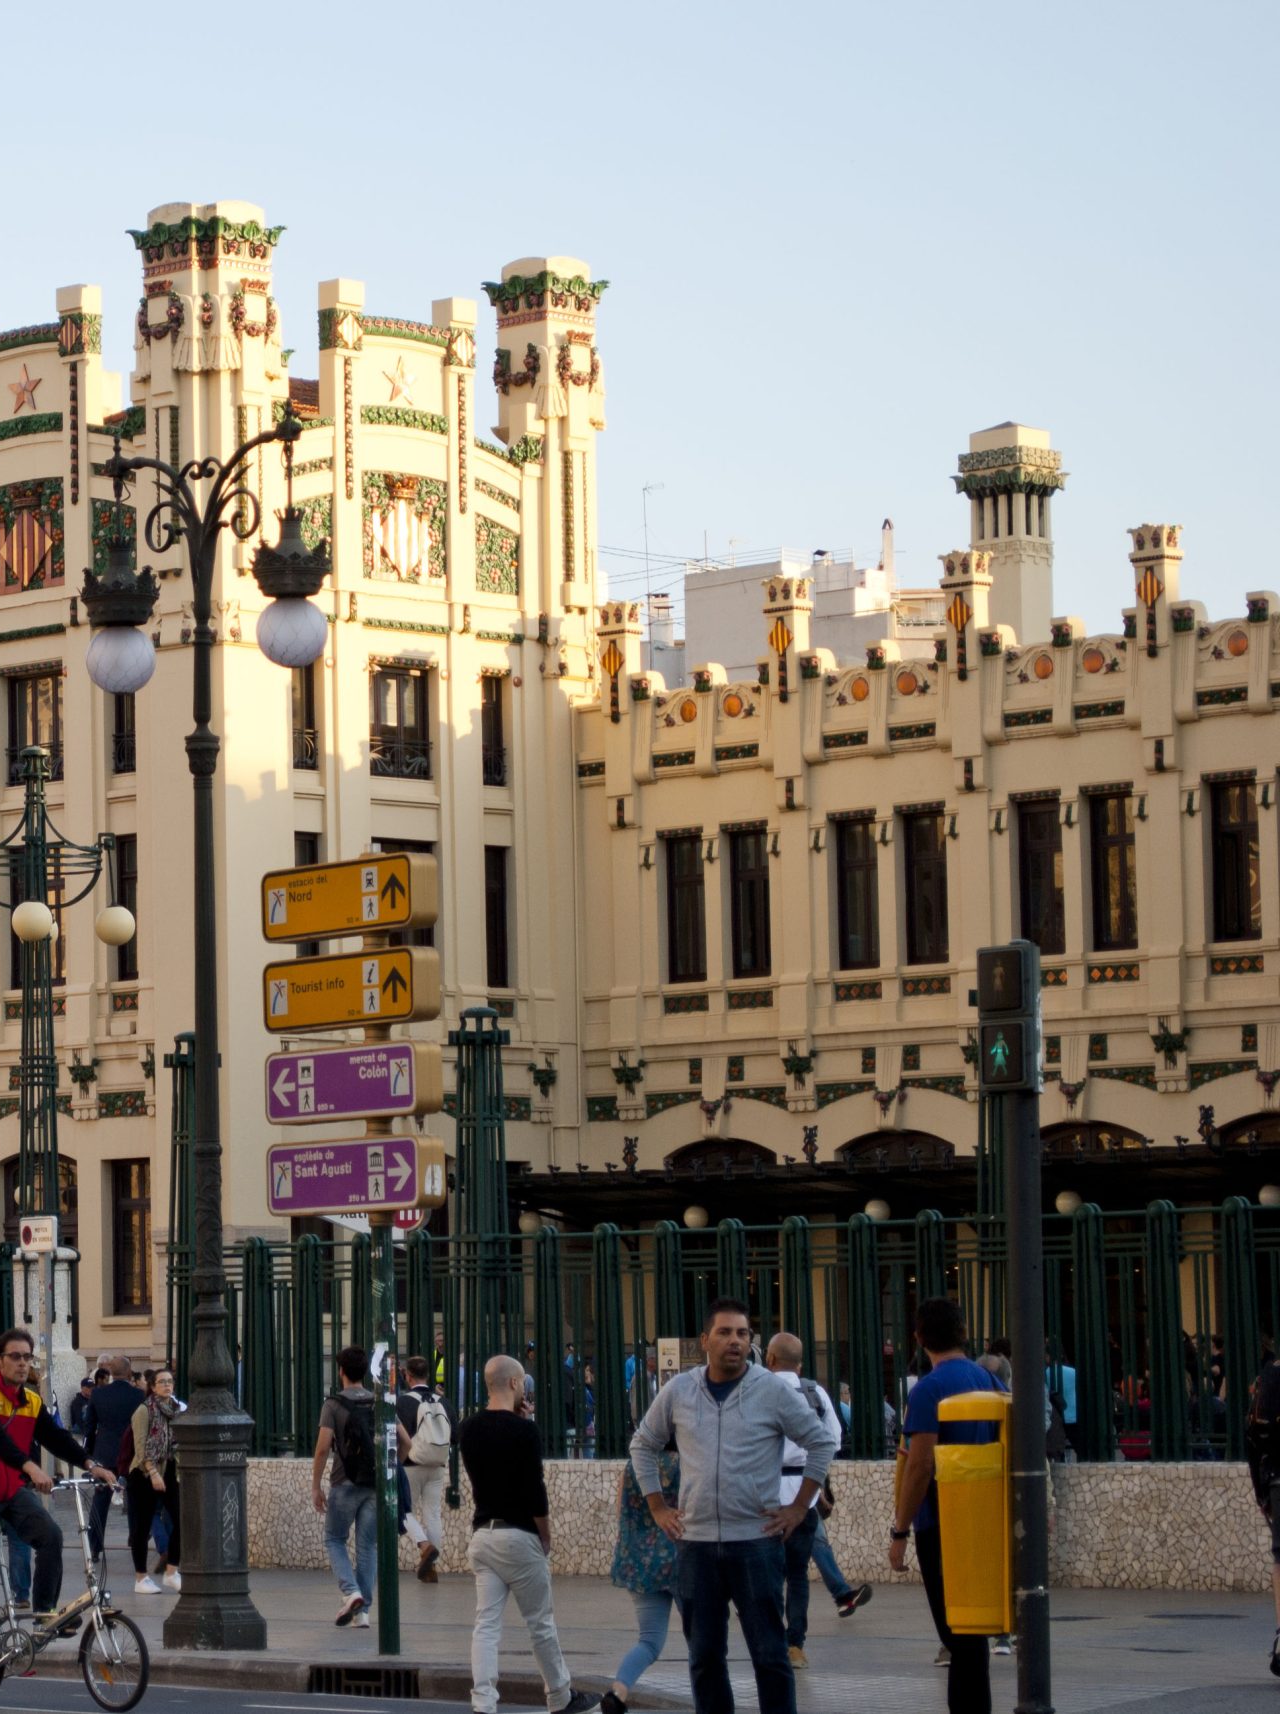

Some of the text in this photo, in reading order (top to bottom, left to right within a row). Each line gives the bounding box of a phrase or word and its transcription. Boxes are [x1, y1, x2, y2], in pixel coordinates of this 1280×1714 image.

[316, 874, 328, 884] del
[289, 890, 312, 903] Nord
[290, 977, 345, 994] Tourist info
[349, 1052, 387, 1065] mercat de
[324, 1149, 335, 1160] de
[294, 1162, 352, 1178] Sant Agustí
